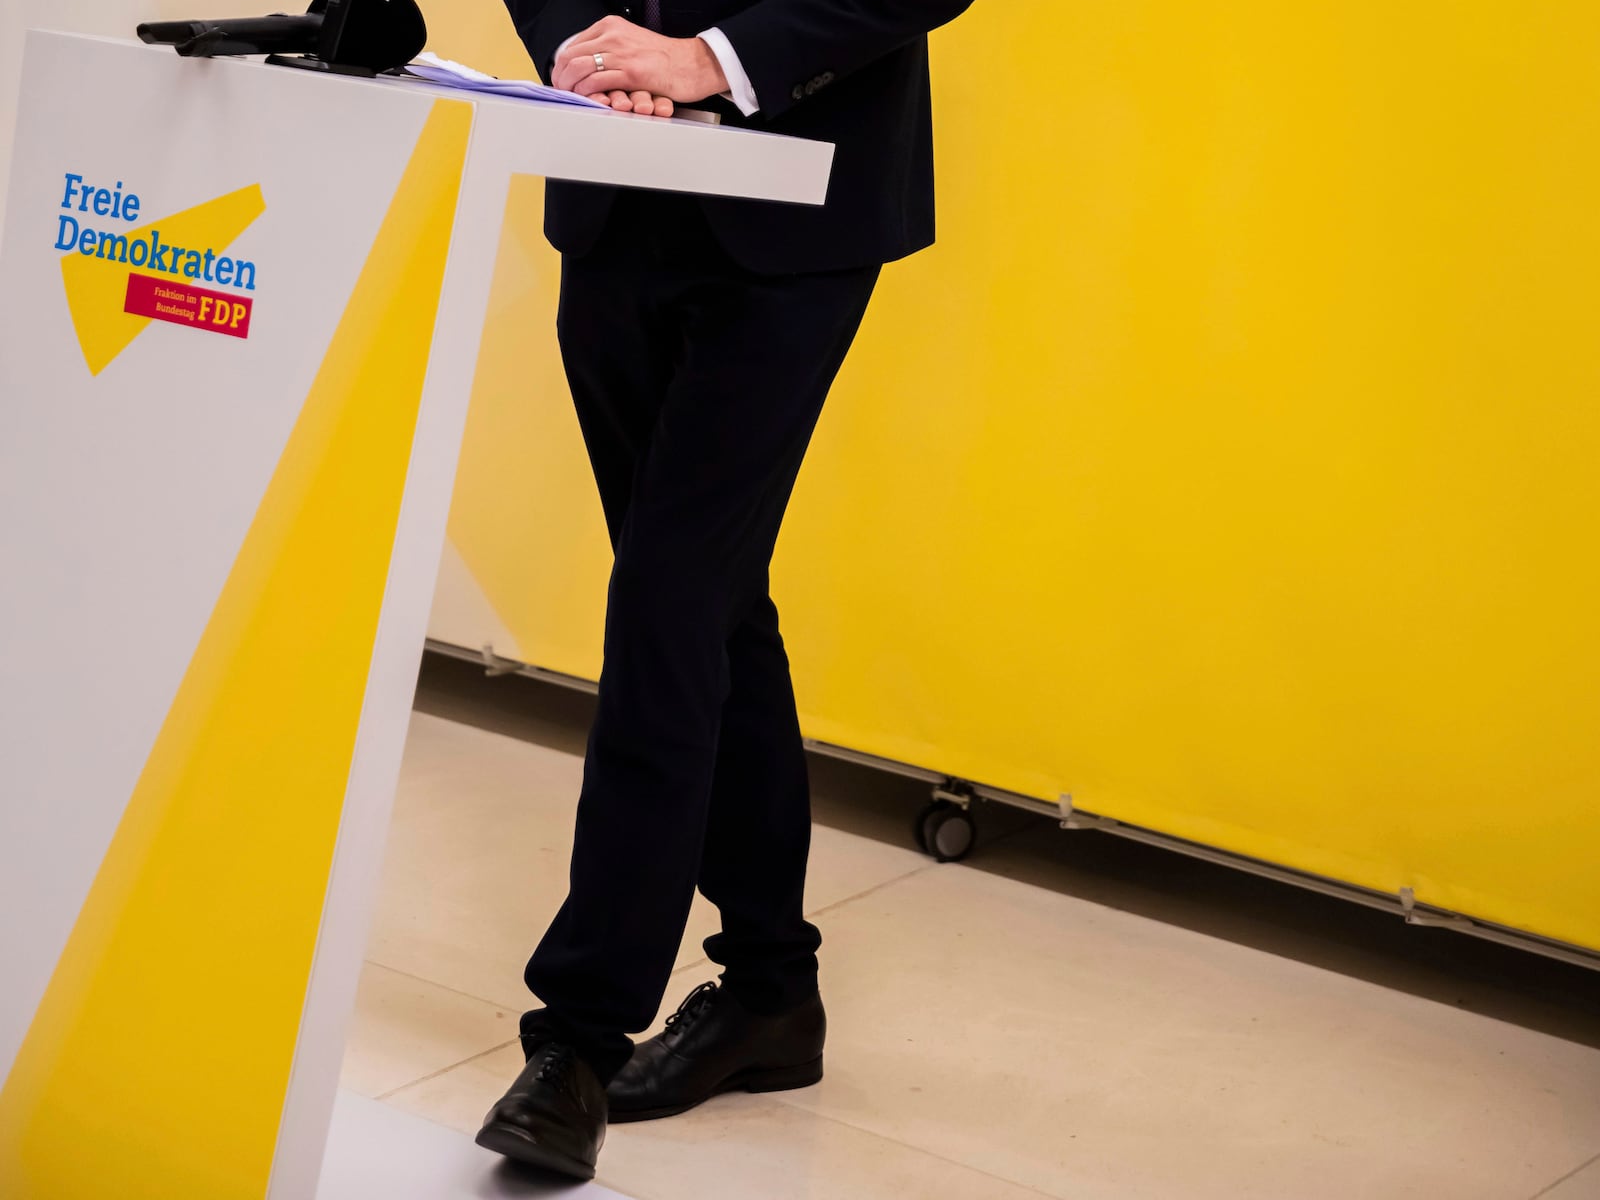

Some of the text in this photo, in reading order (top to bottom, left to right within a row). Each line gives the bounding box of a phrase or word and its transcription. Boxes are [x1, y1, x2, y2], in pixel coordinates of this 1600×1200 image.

[61, 173, 141, 222] Freie
[54, 215, 257, 291] Demokraten
[154, 286, 197, 304] Fraktion im
[155, 302, 196, 321] Bundestag
[197, 295, 247, 329] FDP
